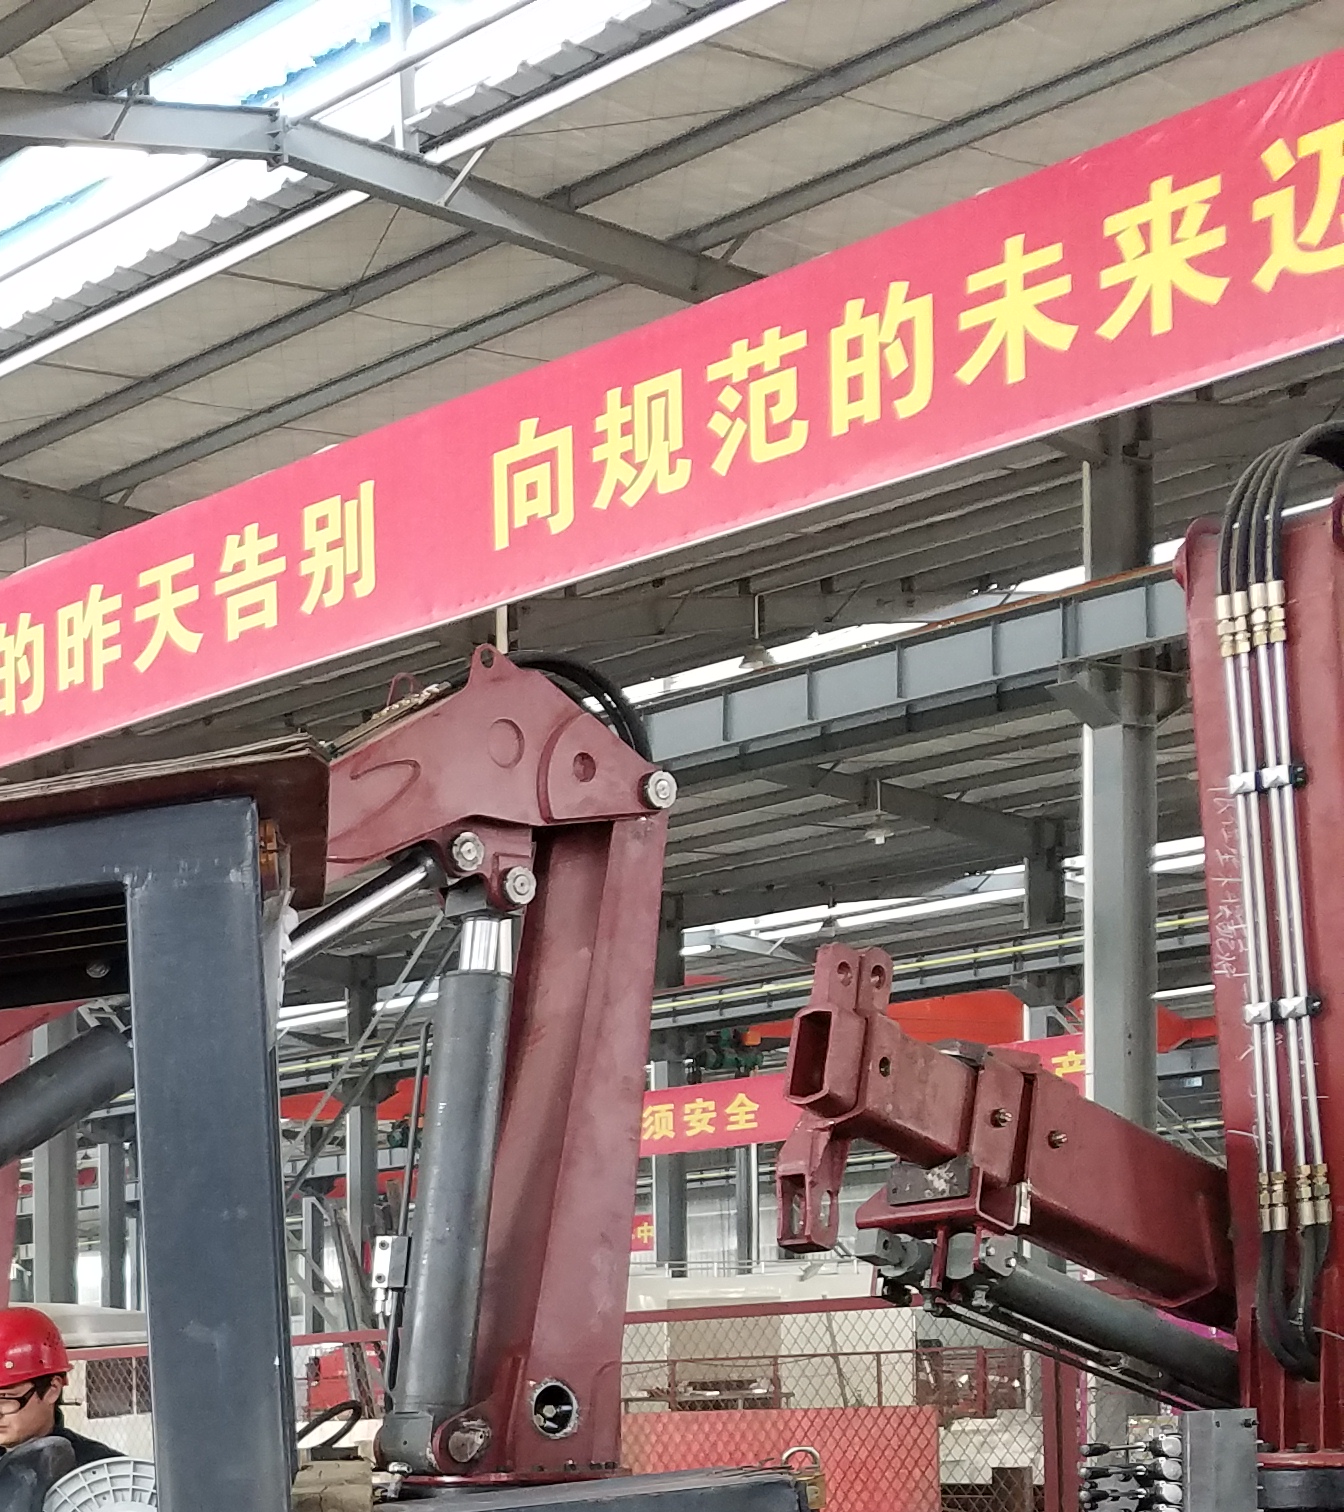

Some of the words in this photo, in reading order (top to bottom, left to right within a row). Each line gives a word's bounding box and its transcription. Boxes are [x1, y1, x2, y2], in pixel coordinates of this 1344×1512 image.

[642, 1092, 760, 1141] 须安全
[632, 1220, 654, 1245] 中
